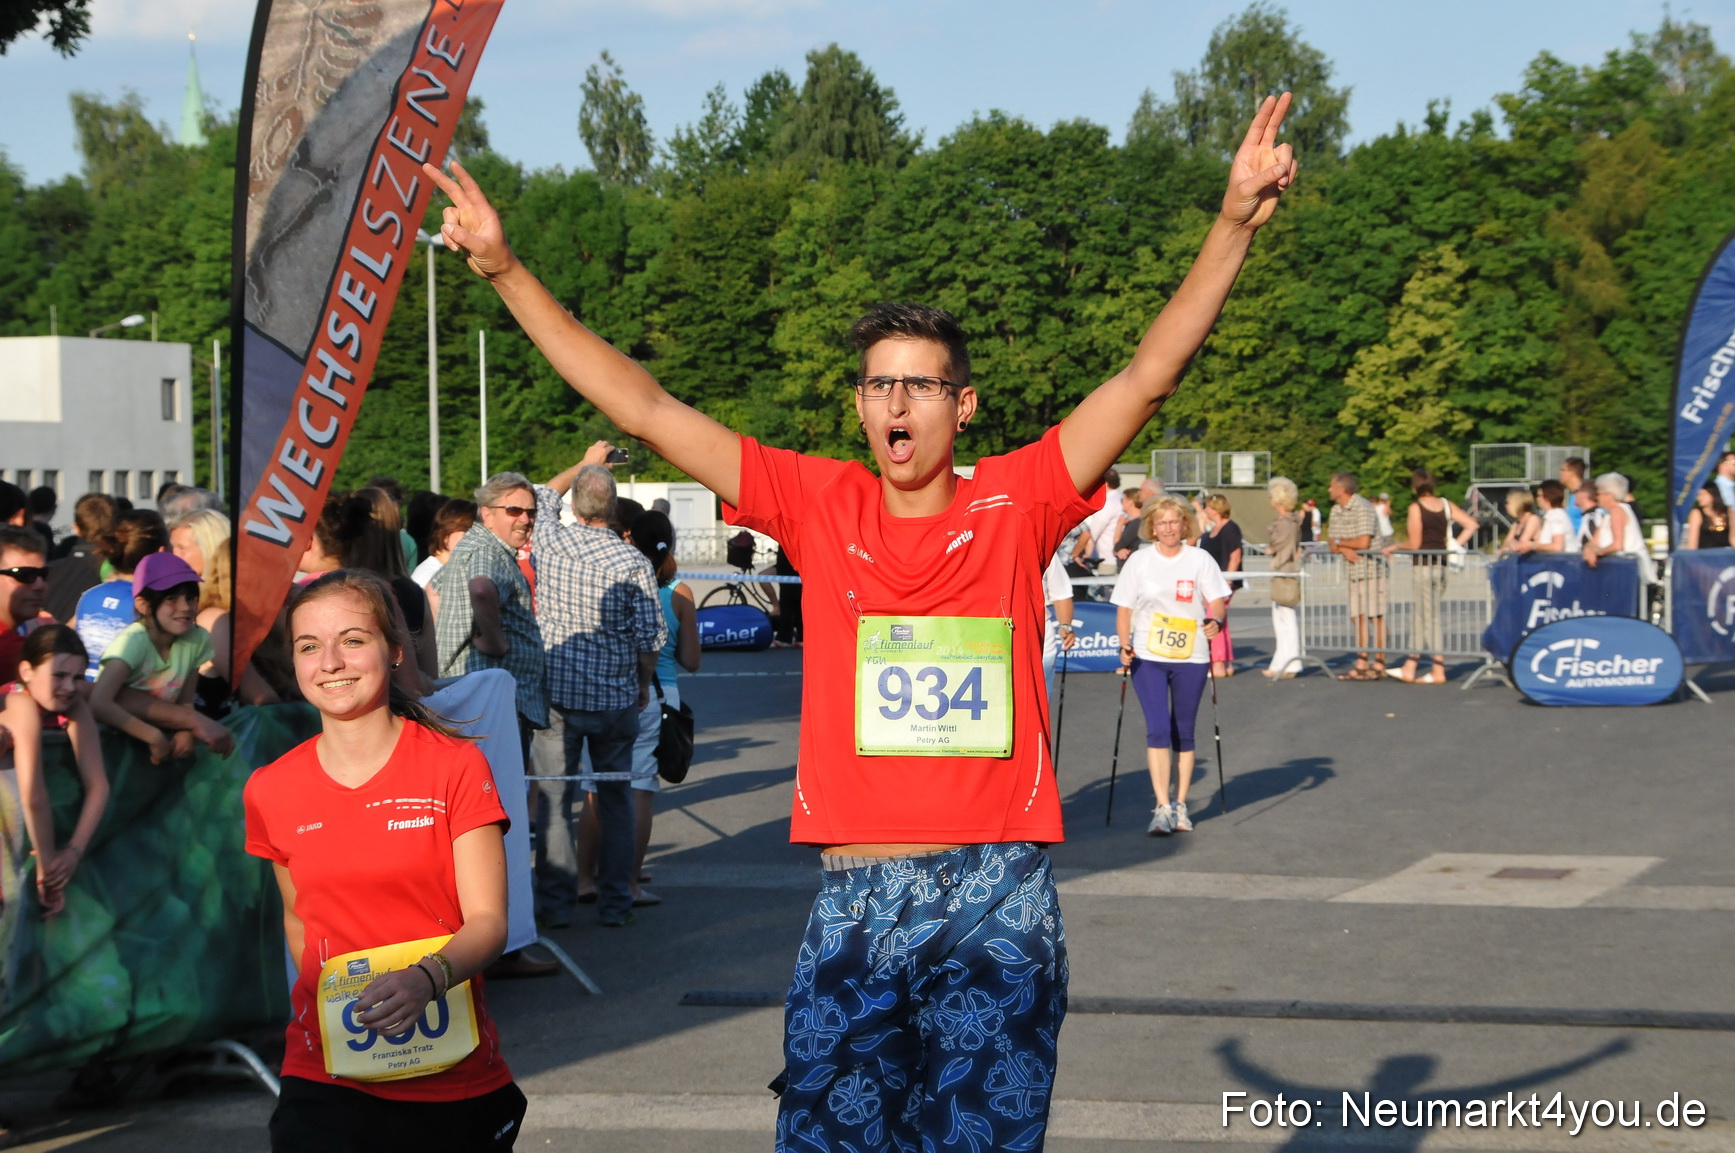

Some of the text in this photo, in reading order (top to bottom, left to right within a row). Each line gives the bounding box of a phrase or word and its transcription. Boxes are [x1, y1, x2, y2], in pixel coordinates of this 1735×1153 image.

[698, 626, 759, 644] ischer
[1156, 629, 1187, 648] 158
[880, 640, 935, 650] firmenlauf
[1554, 654, 1664, 678] Fischer
[1565, 675, 1655, 688] AUTOMOBILE
[877, 666, 988, 721] 934
[910, 724, 957, 733] Martin Wittl
[916, 737, 936, 745] Petry
[305, 822, 323, 832] JAKO
[372, 1044, 434, 1060] Franziska Tratz
[388, 1057, 421, 1069] Petry AG
